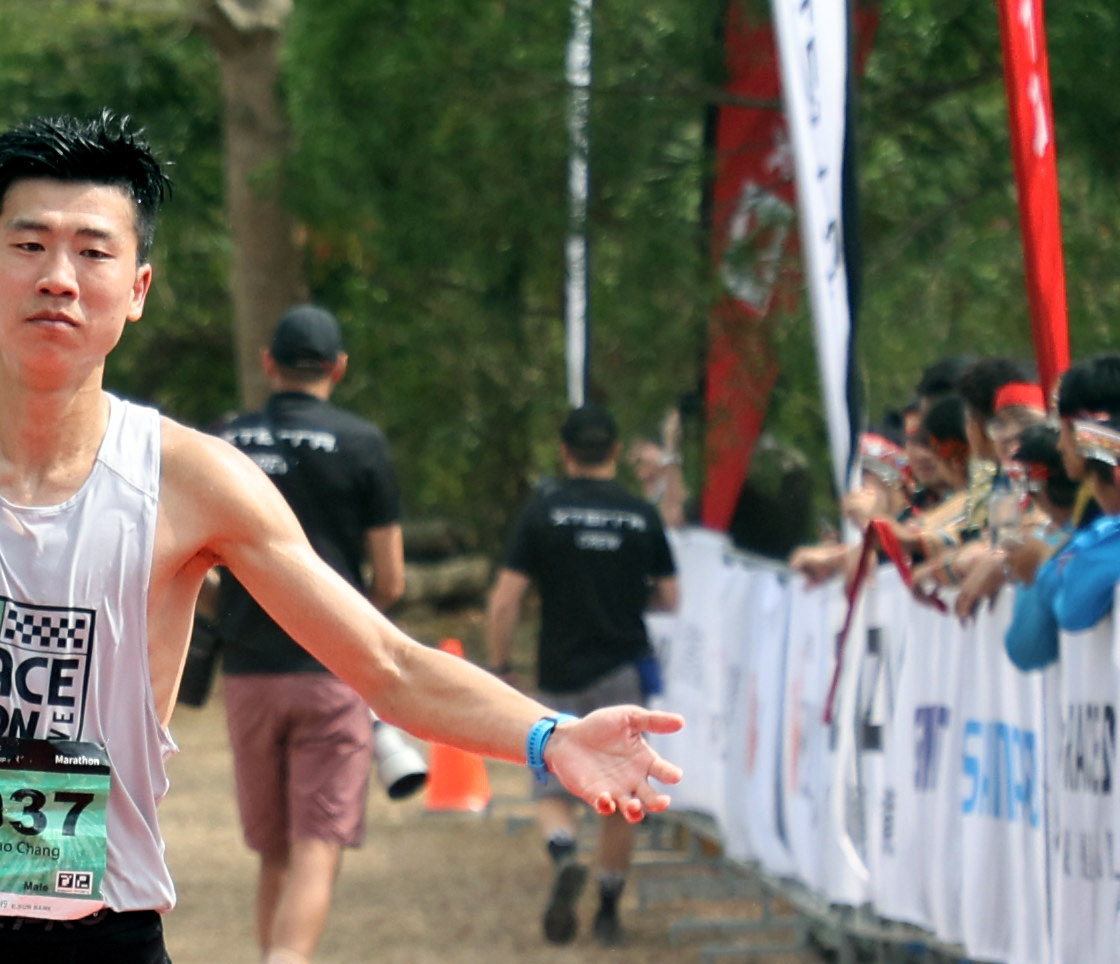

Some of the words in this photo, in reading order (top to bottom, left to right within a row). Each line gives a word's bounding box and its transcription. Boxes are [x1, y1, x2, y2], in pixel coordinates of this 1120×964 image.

[55, 754, 100, 766] Marathon
[16, 841, 60, 860] Chang
[23, 881, 49, 892] Male
